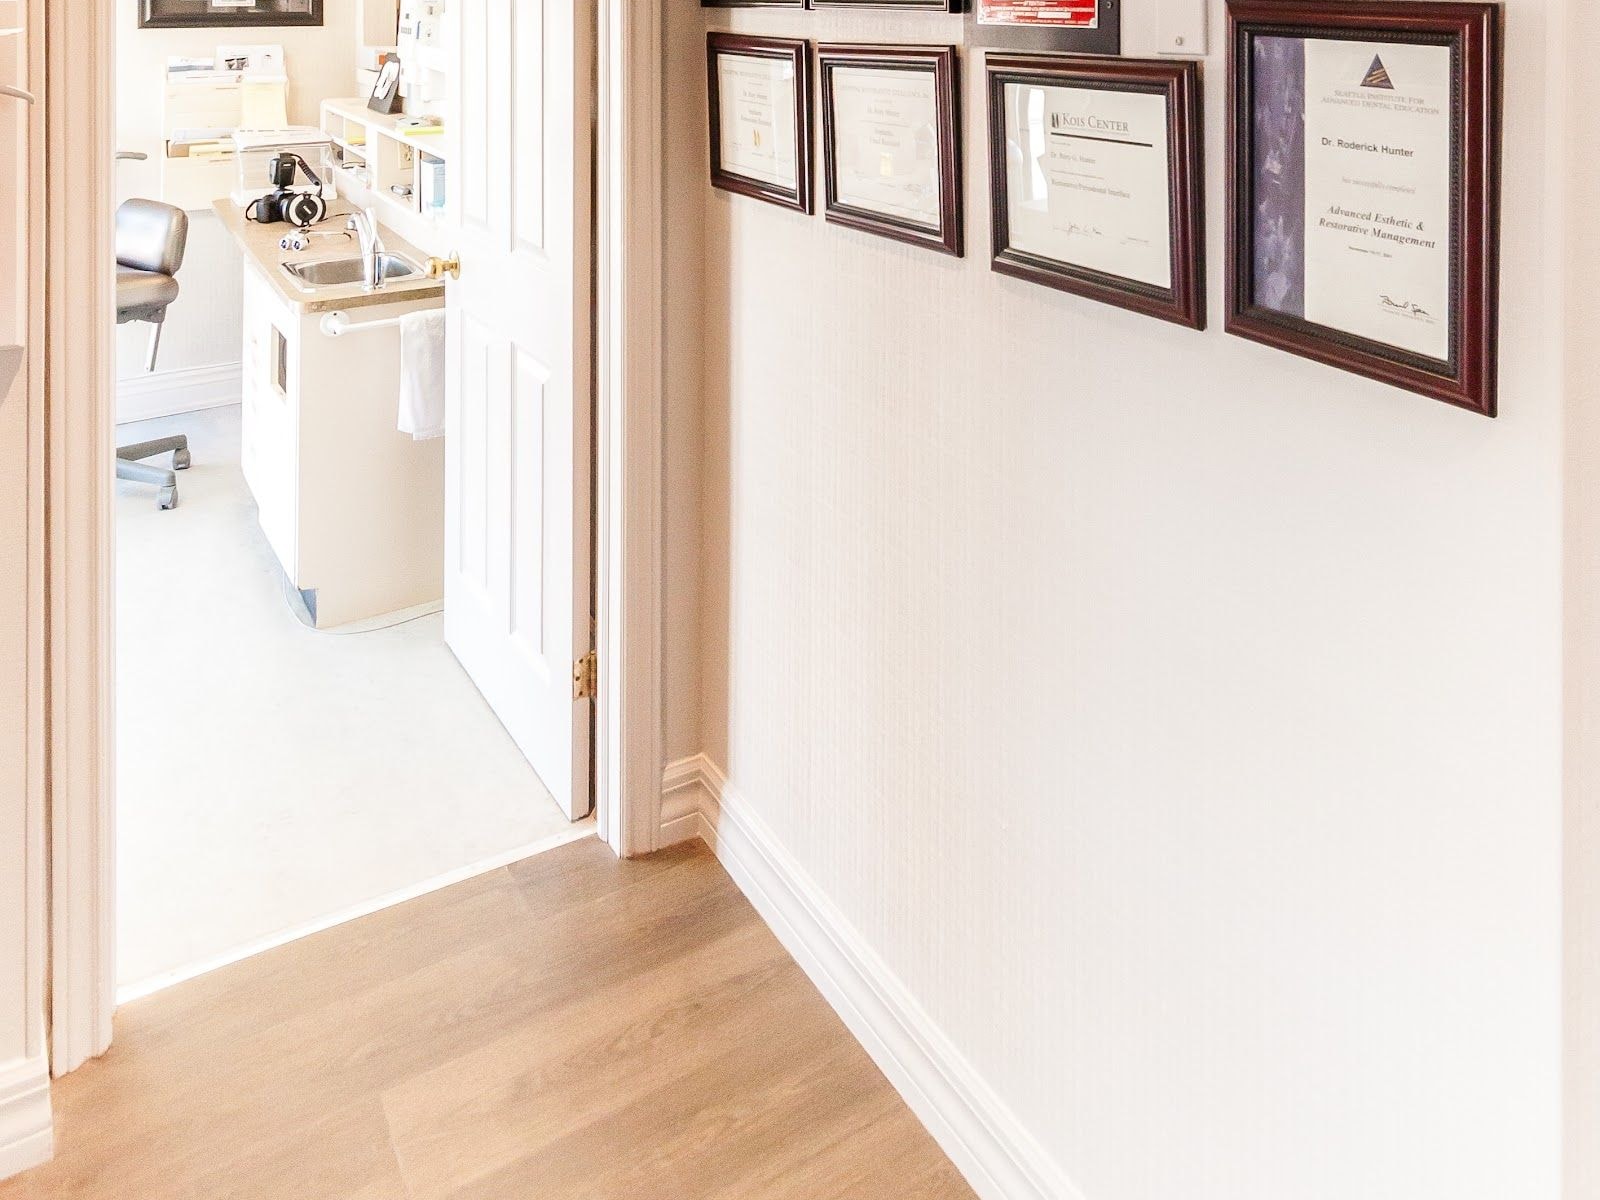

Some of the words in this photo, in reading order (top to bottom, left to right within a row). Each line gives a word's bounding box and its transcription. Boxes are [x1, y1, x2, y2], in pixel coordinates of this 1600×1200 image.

[1408, 96, 1424, 104] FOR
[1061, 112, 1085, 126] KOIS
[1087, 115, 1128, 131] CENTER
[1321, 137, 1333, 145] Dr.
[1336, 139, 1377, 152] Roderick
[1380, 145, 1413, 157] Hunter
[1329, 205, 1371, 221] Advanced
[1373, 213, 1410, 228] Esthetic
[1415, 221, 1424, 231] &
[1318, 217, 1368, 234] Restorative
[1372, 227, 1435, 248] Management
